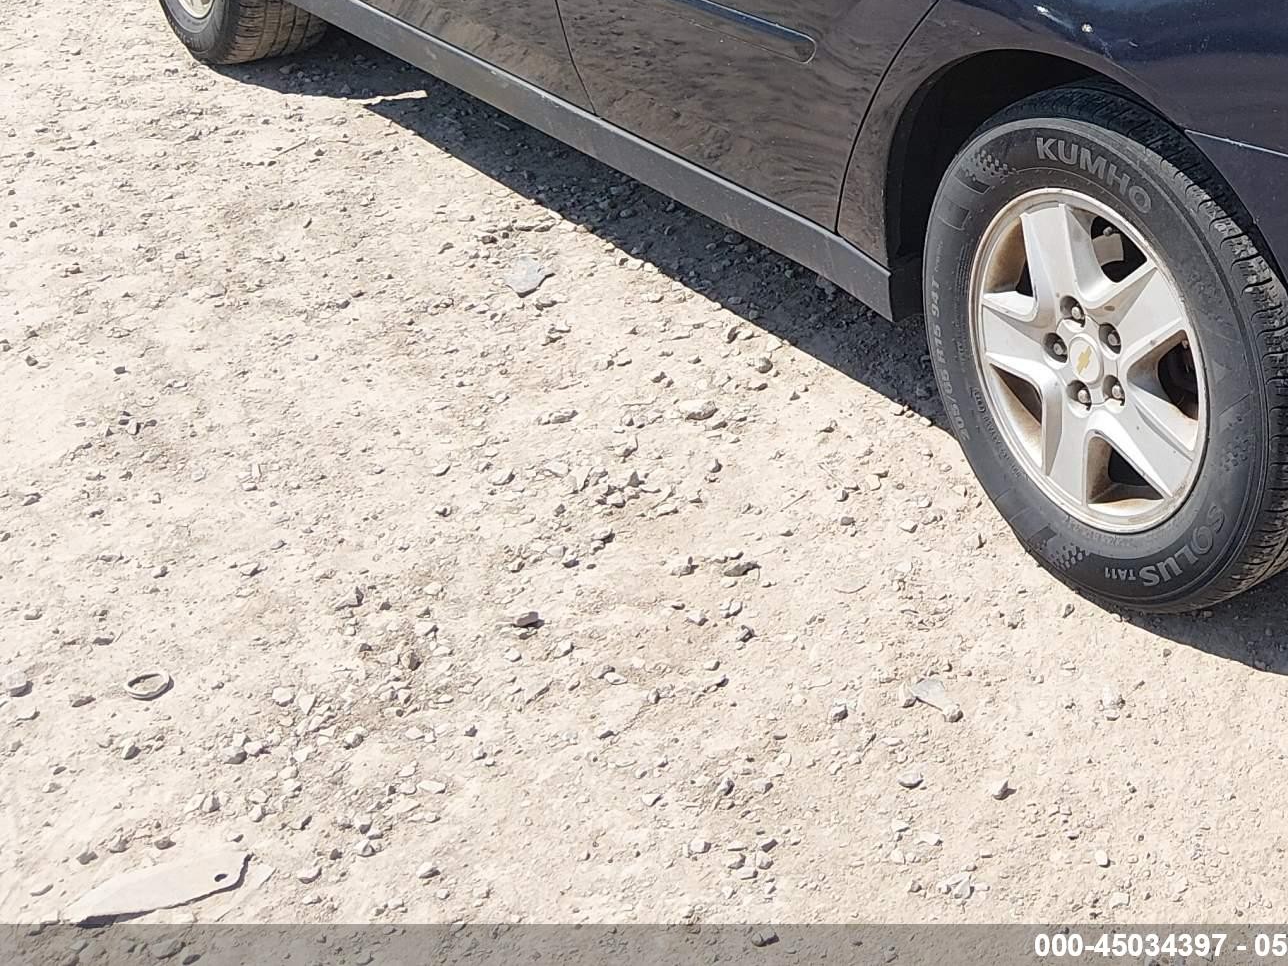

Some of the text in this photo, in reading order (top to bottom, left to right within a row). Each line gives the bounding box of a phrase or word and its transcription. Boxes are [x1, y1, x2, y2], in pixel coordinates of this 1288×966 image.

[1035, 136, 1153, 215] KUMHO
[932, 323, 947, 365] R15
[938, 367, 972, 443] 205/65
[1103, 503, 1226, 588] SOLUS TA11
